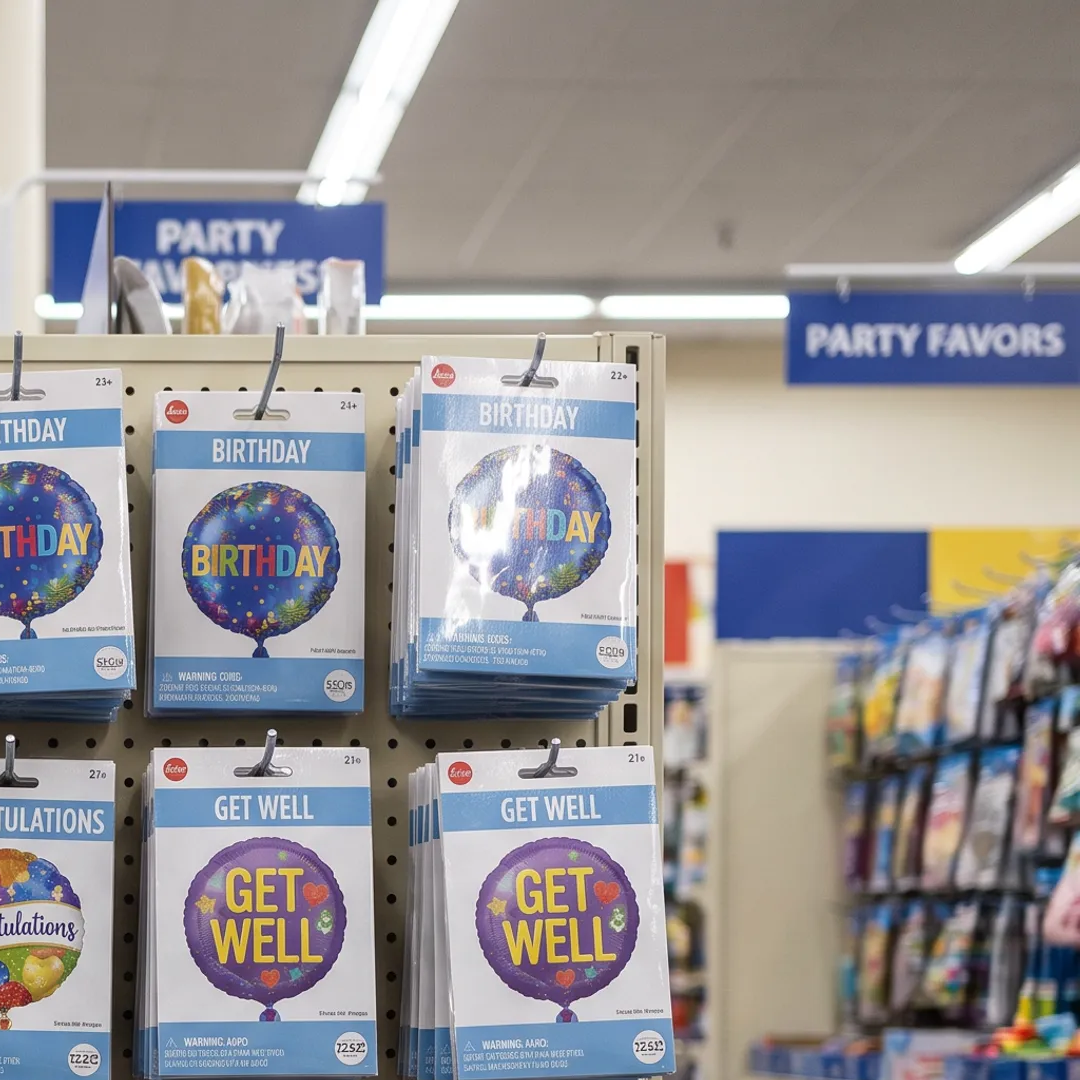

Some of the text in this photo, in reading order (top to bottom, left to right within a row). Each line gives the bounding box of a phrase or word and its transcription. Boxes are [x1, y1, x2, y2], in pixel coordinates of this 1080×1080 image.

[156, 219, 284, 255] PARTY
[805, 322, 1066, 358] PARTY FAVORS
[479, 402, 579, 431] BIRTHDAY
[213, 438, 311, 464] BIRTHDAY
[462, 507, 602, 543] THDAY
[192, 544, 331, 577] BIRTHDAY
[178, 671, 217, 682] WARNING
[214, 795, 314, 821] GET WELL
[500, 795, 601, 823] GET WELL
[225, 867, 304, 914] GET
[515, 867, 593, 915] GET
[210, 917, 323, 964] WELL
[502, 916, 616, 966] WELL
